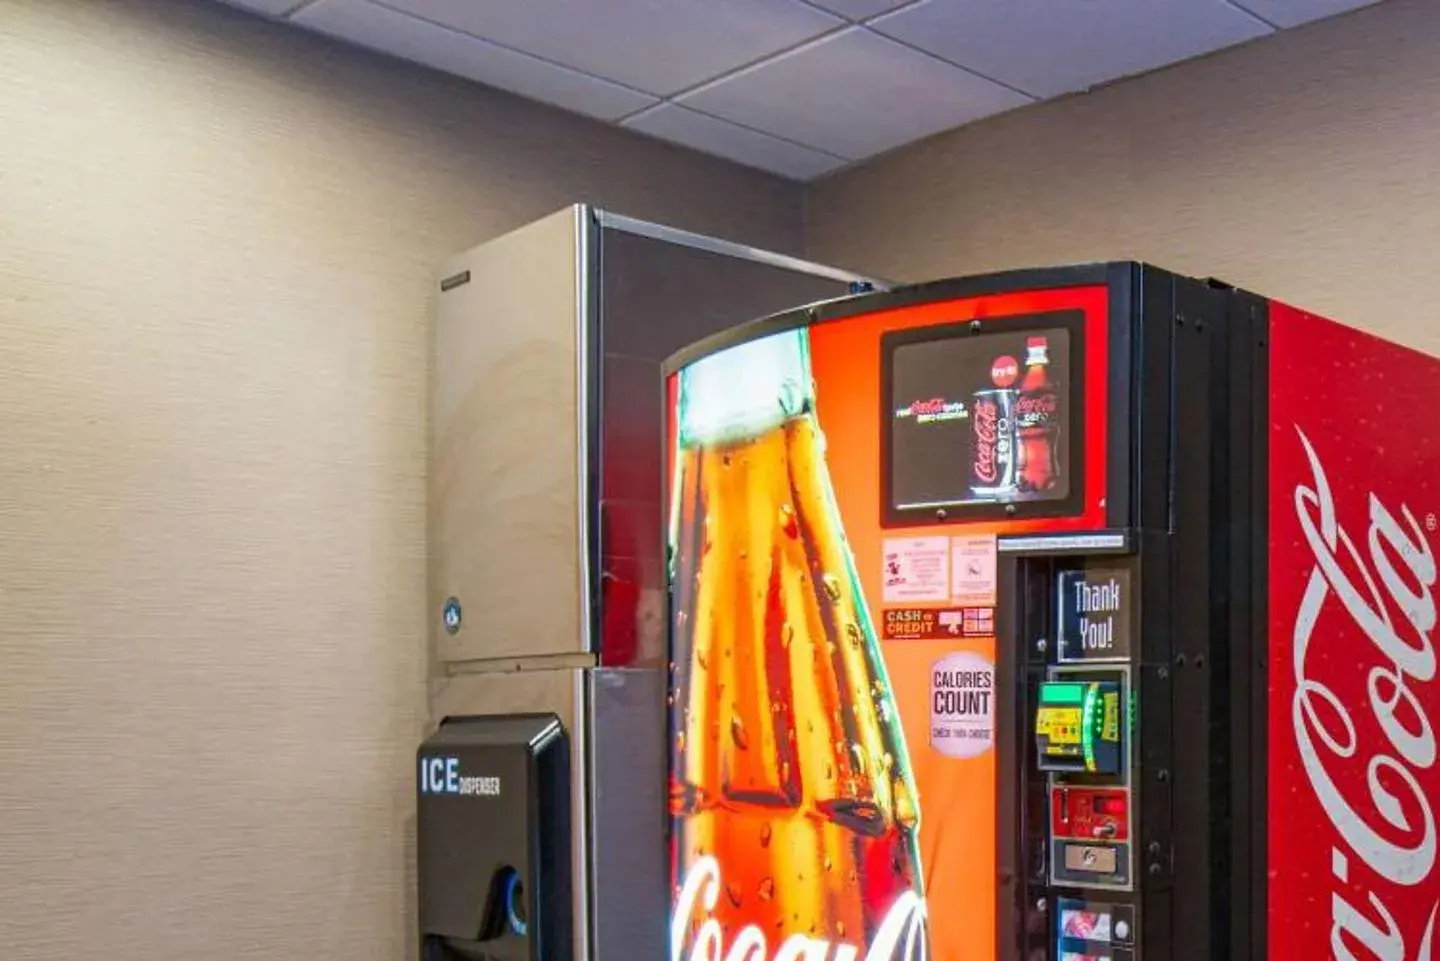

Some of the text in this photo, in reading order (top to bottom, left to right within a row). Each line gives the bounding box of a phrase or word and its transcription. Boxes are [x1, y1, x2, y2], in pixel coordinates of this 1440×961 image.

[1075, 580, 1120, 613] Thank
[886, 610, 922, 622] CASH
[886, 621, 934, 634] CREDIT
[1079, 617, 1112, 649] You!
[934, 671, 992, 688] CALORIES
[934, 690, 991, 715] COUNT
[421, 757, 501, 796] ICE DISPENSER
